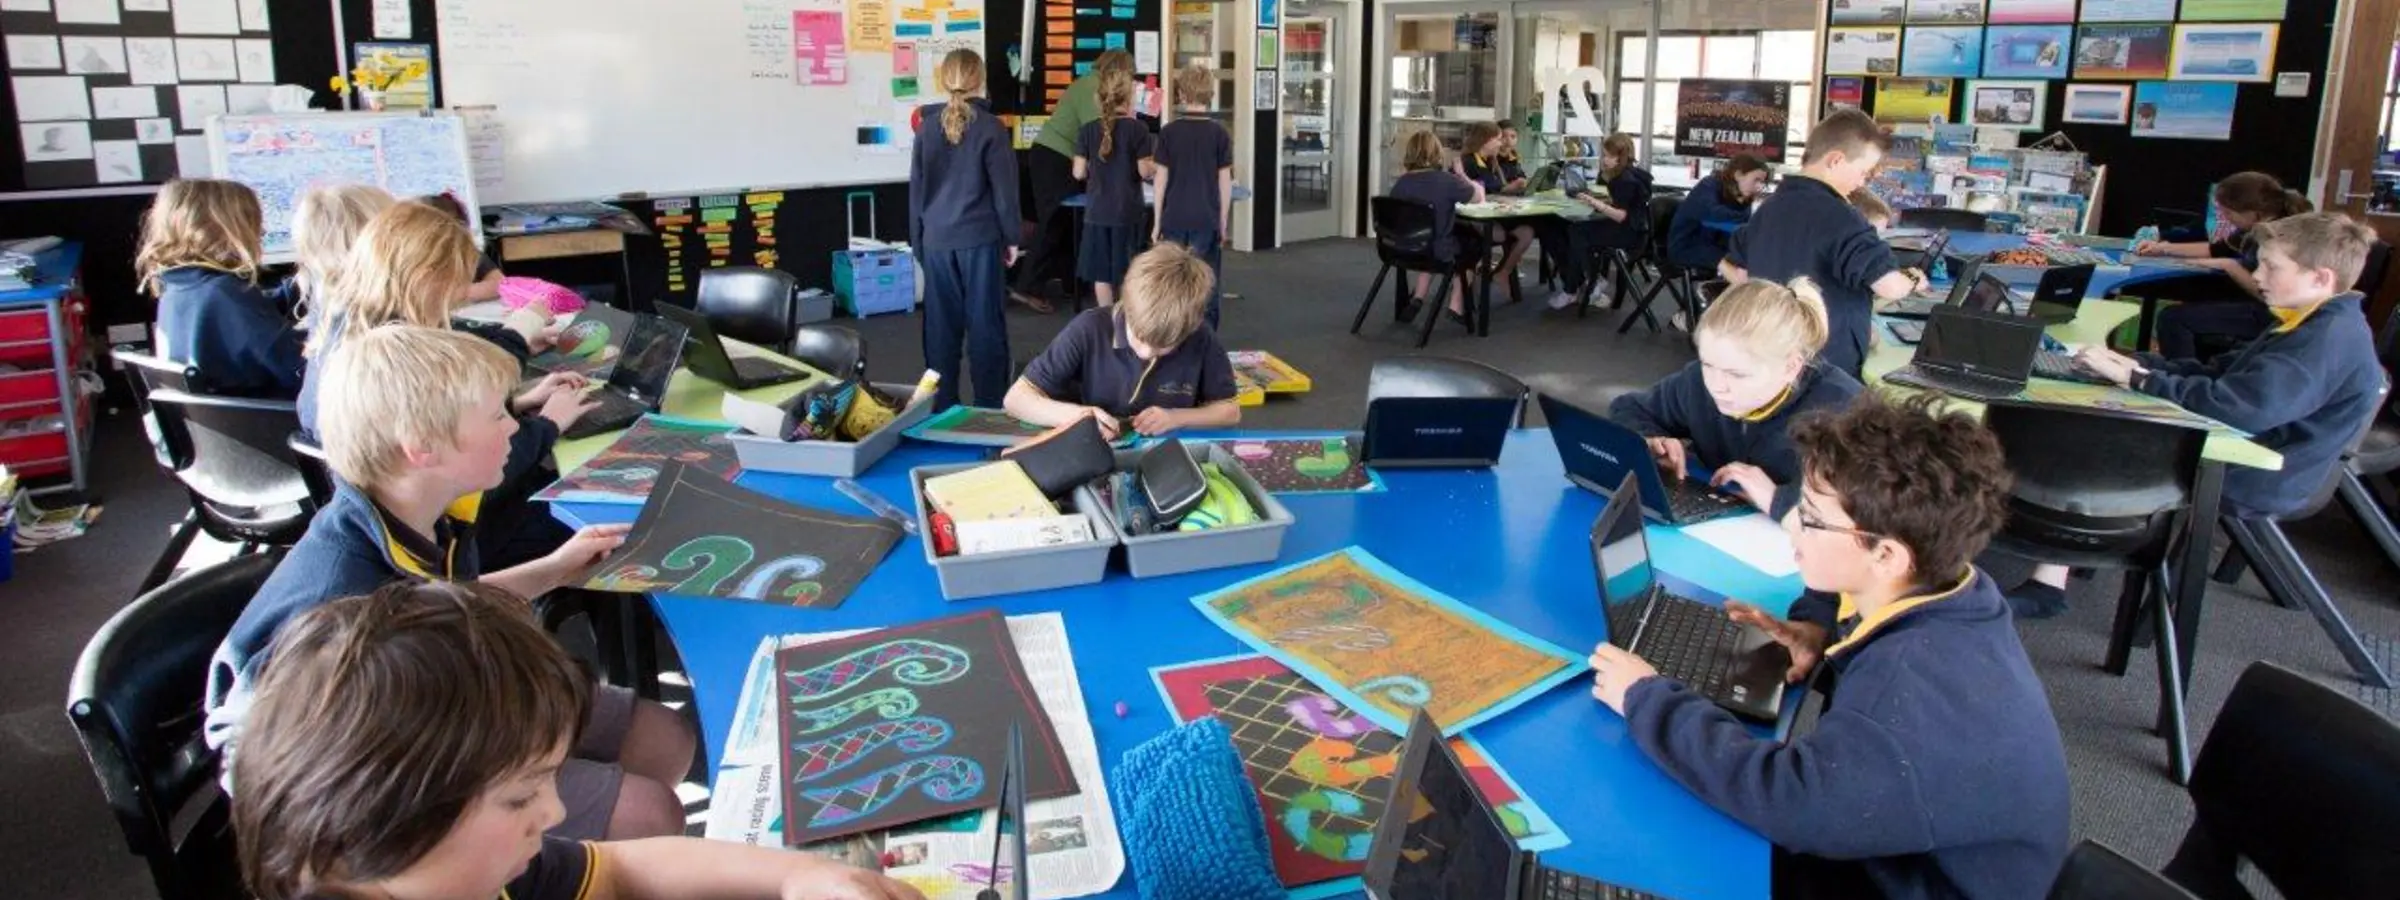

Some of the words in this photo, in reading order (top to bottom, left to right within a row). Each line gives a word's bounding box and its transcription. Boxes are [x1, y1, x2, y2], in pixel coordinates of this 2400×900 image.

[1688, 128, 1714, 142] NEW
[1714, 129, 1764, 147] ZEALAND
[1414, 427, 1463, 436] TOSHIBA
[1579, 442, 1619, 464] TOSHIBA
[749, 796, 771, 829] racing
